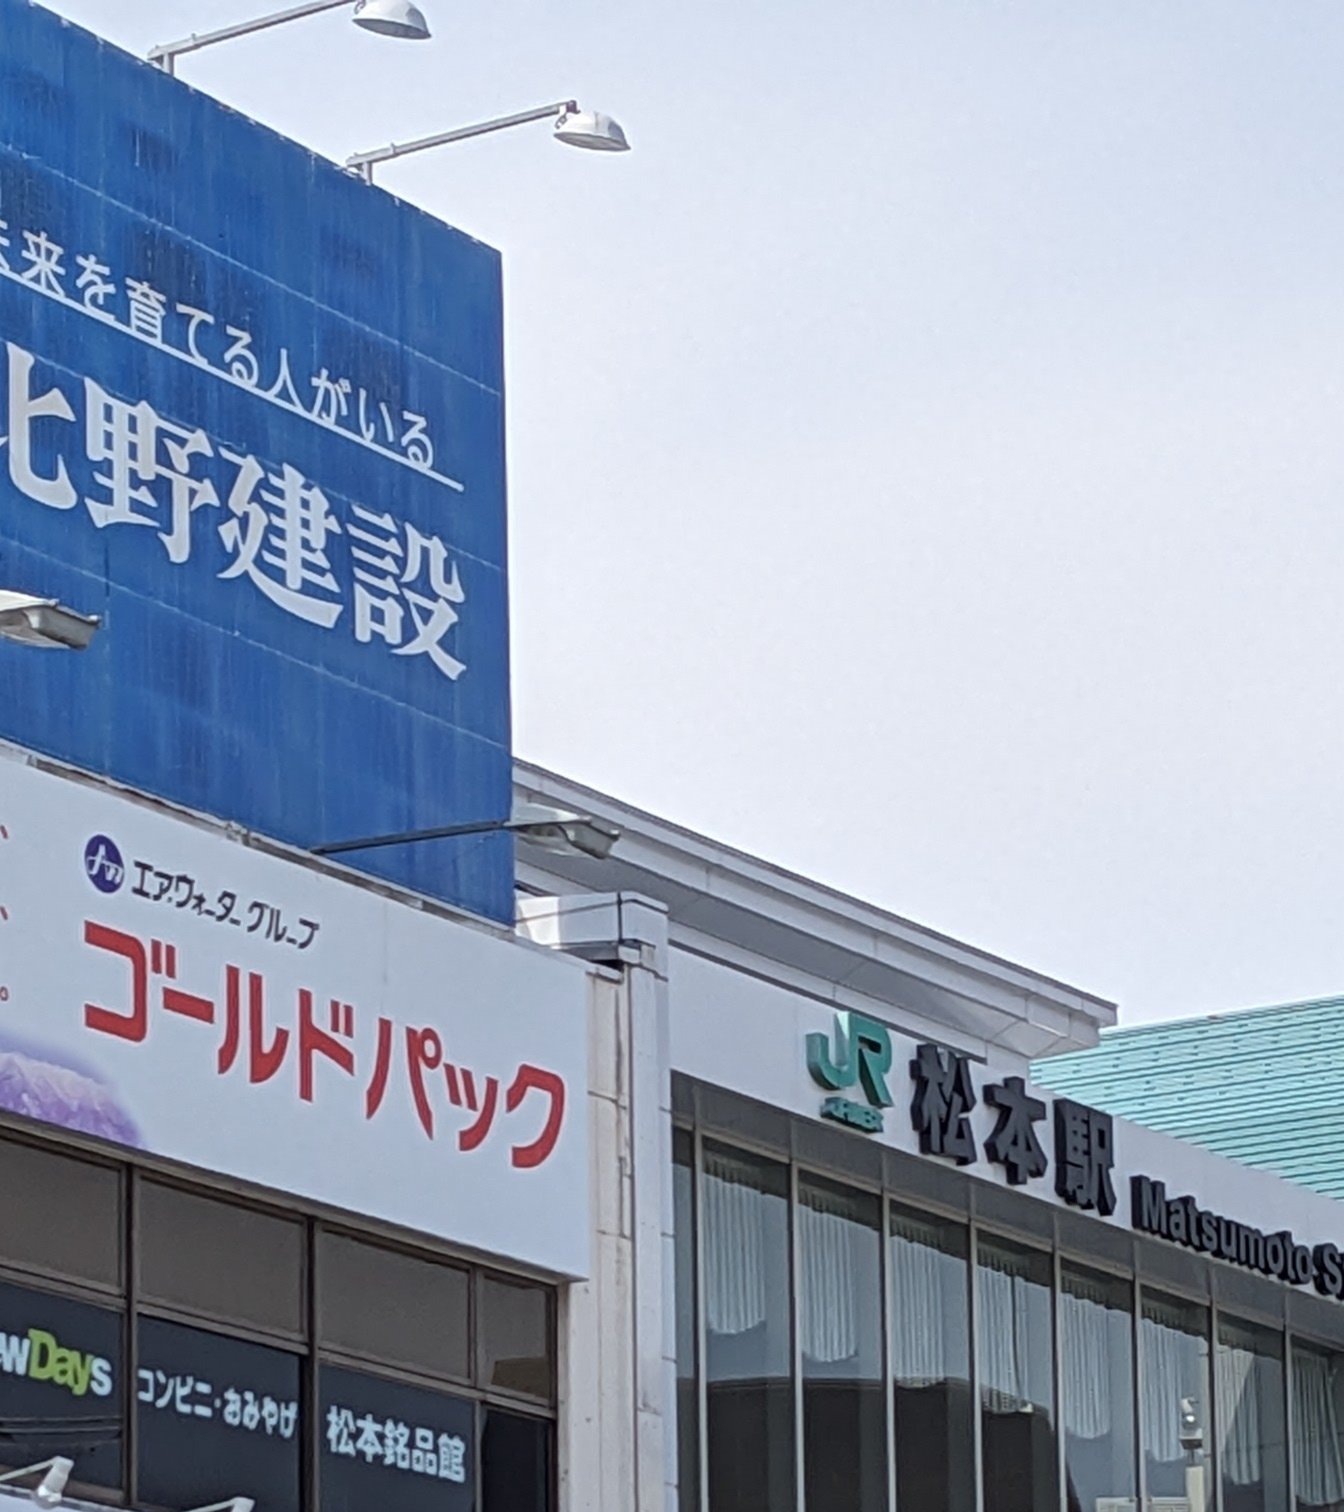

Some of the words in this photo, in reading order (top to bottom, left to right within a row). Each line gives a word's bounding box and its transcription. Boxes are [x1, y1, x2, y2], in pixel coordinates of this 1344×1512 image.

[84, 920, 565, 1168] ゴールドパック
[806, 1010, 893, 1108] JR
[911, 1043, 1116, 1216] 松本駅
[1131, 1174, 1314, 1284] Matsumoto
[137, 1369, 298, 1439] コンビニ・おみやげ
[326, 1405, 467, 1483] 松本銘品館
